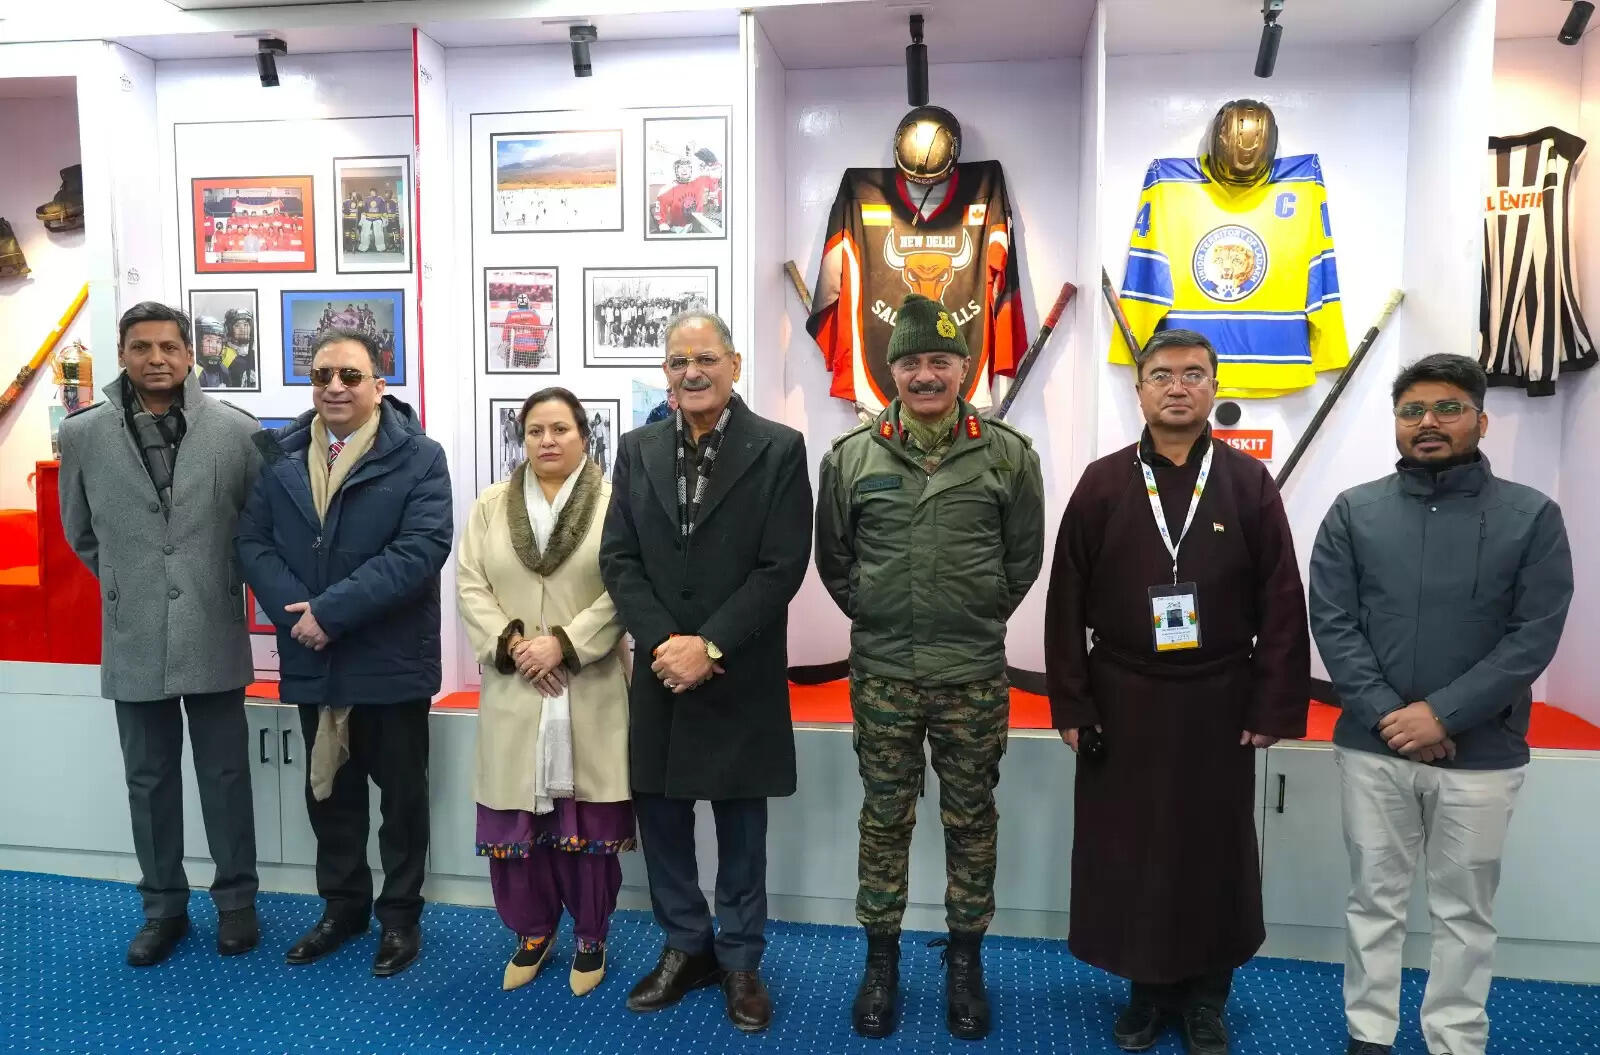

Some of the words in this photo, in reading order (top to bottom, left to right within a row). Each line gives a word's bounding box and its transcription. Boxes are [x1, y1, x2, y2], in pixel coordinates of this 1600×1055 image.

[1275, 192, 1296, 218] C
[1134, 202, 1151, 238] 4
[899, 235, 924, 248] NEW
[926, 235, 956, 248] DELHI
[1196, 253, 1208, 283] UNION
[1251, 246, 1264, 283] LADAKH
[871, 299, 898, 327] SAL
[951, 299, 981, 327] LLS
[1221, 437, 1267, 451] SKIT
